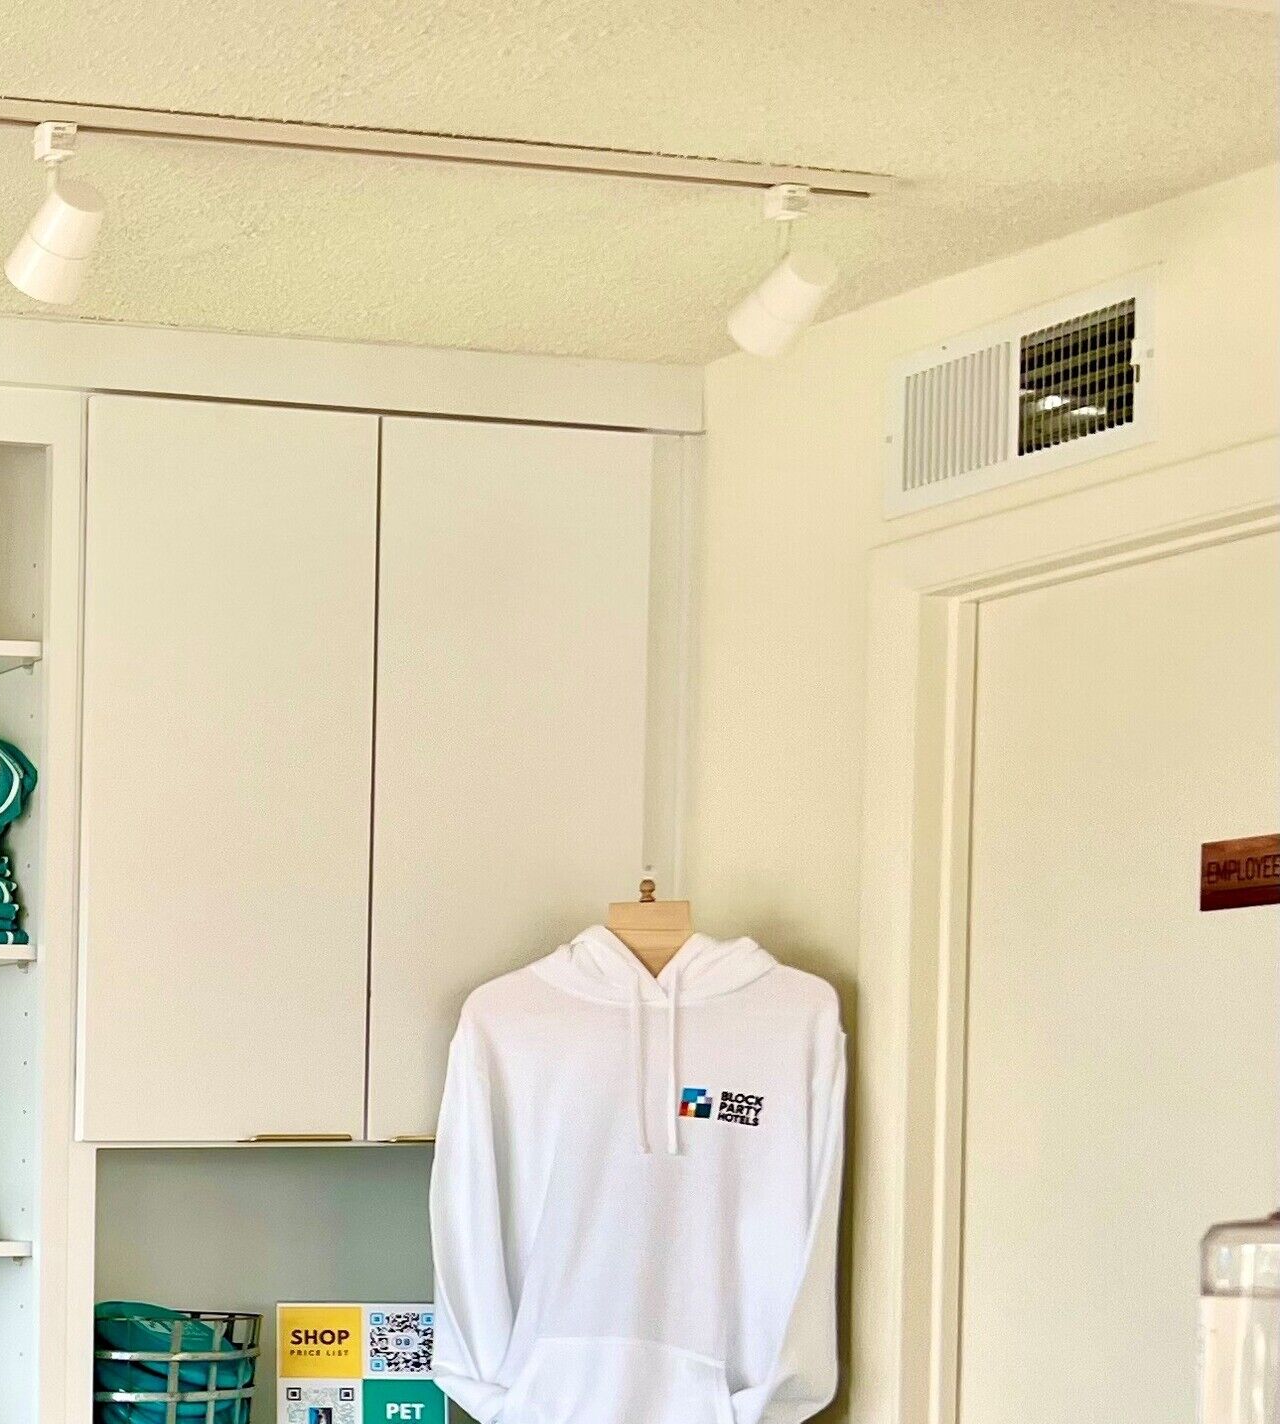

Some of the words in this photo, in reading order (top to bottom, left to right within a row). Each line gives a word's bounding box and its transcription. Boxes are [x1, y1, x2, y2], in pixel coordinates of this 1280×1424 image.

[720, 1091, 764, 1106] BLOCK
[719, 1101, 762, 1116] PARTY
[717, 1113, 759, 1126] HOTELS
[290, 1329, 350, 1346] SHOP
[385, 1403, 425, 1420] PET
